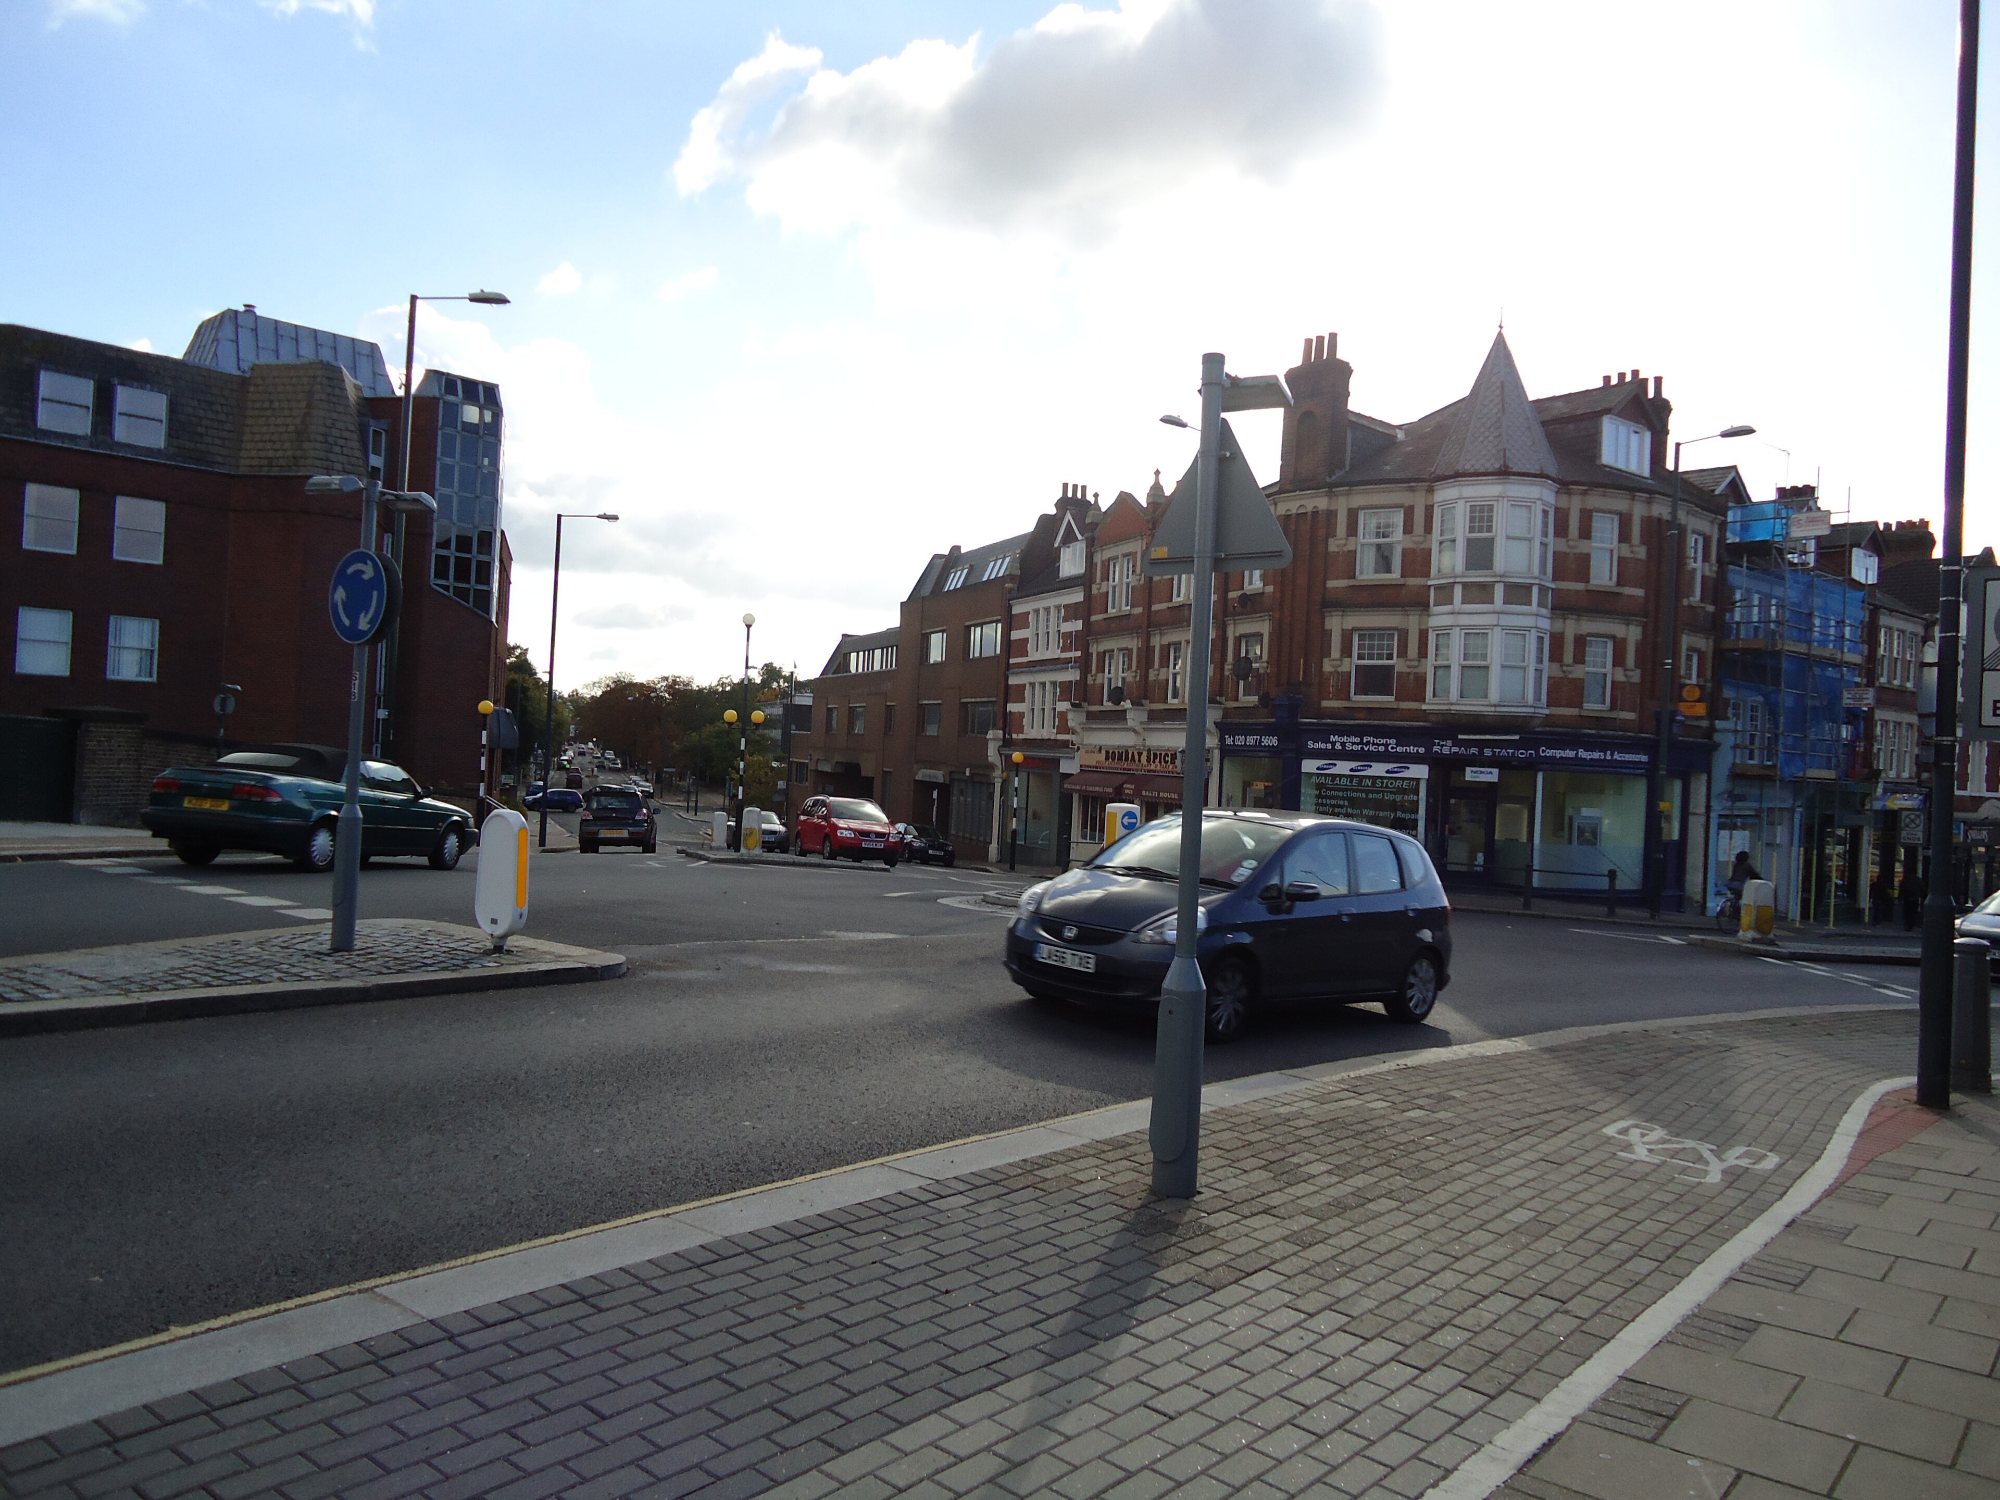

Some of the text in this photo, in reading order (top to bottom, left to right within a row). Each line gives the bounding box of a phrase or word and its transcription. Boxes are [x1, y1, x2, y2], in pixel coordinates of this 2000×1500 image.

[1235, 735, 1245, 746] 020
[1246, 736, 1260, 747] 8977
[1261, 736, 1279, 747] 5606
[1329, 734, 1397, 745] Mobile Phone
[1307, 741, 1426, 754] Sales & Service Centre
[1432, 746, 1536, 758] REPAIR STATION
[1104, 748, 1178, 765] BOMBAY SPICE
[1540, 747, 1649, 762] Computer Repairs & Accessories
[1311, 776, 1359, 786] AVAILABLE
[1362, 778, 1372, 786] IN
[1321, 788, 1366, 798] Connections
[1368, 791, 1384, 799] and
[1334, 806, 1347, 814] and
[1347, 806, 1361, 814] Non
[1362, 808, 1395, 819] Warranty
